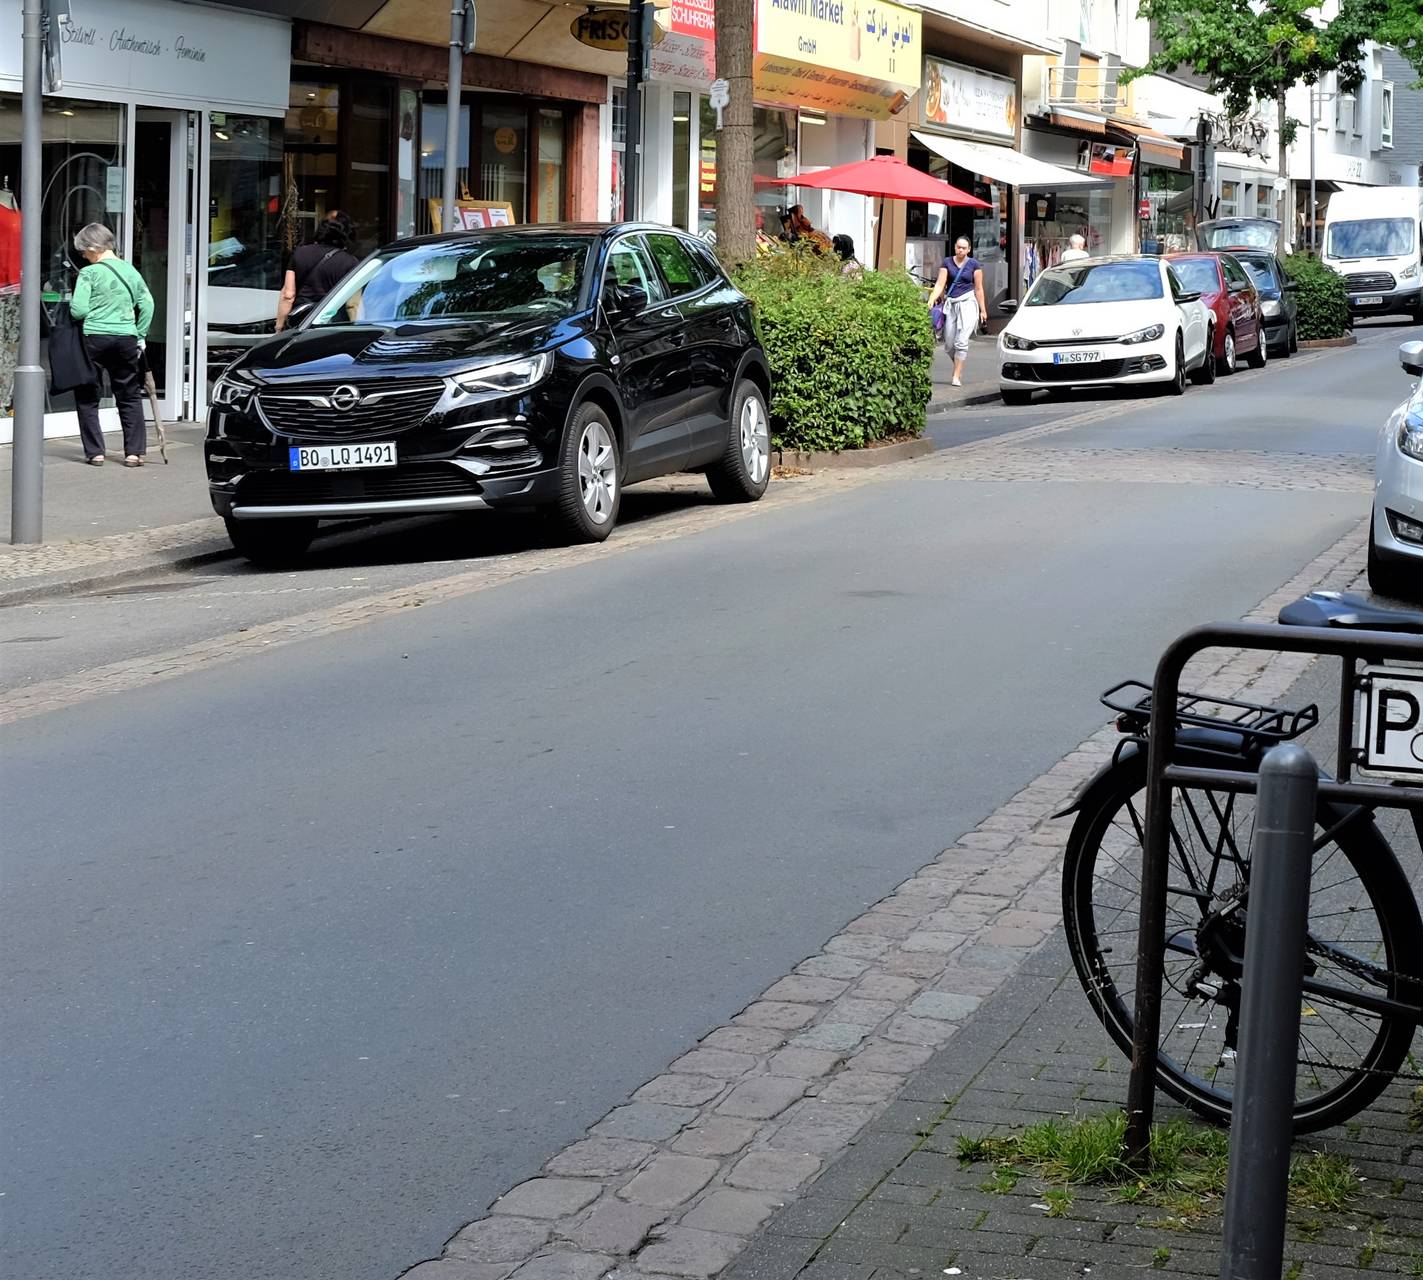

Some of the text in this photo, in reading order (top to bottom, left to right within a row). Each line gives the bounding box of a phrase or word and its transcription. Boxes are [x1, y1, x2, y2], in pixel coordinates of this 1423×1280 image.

[810, 0, 844, 25] Market
[798, 36, 817, 54] GmbH
[1070, 353, 1081, 362] SG
[1083, 352, 1099, 361] 797
[300, 449, 319, 466] BO
[330, 447, 351, 465] LQ
[354, 445, 393, 464] 1491
[1376, 689, 1420, 754] P
